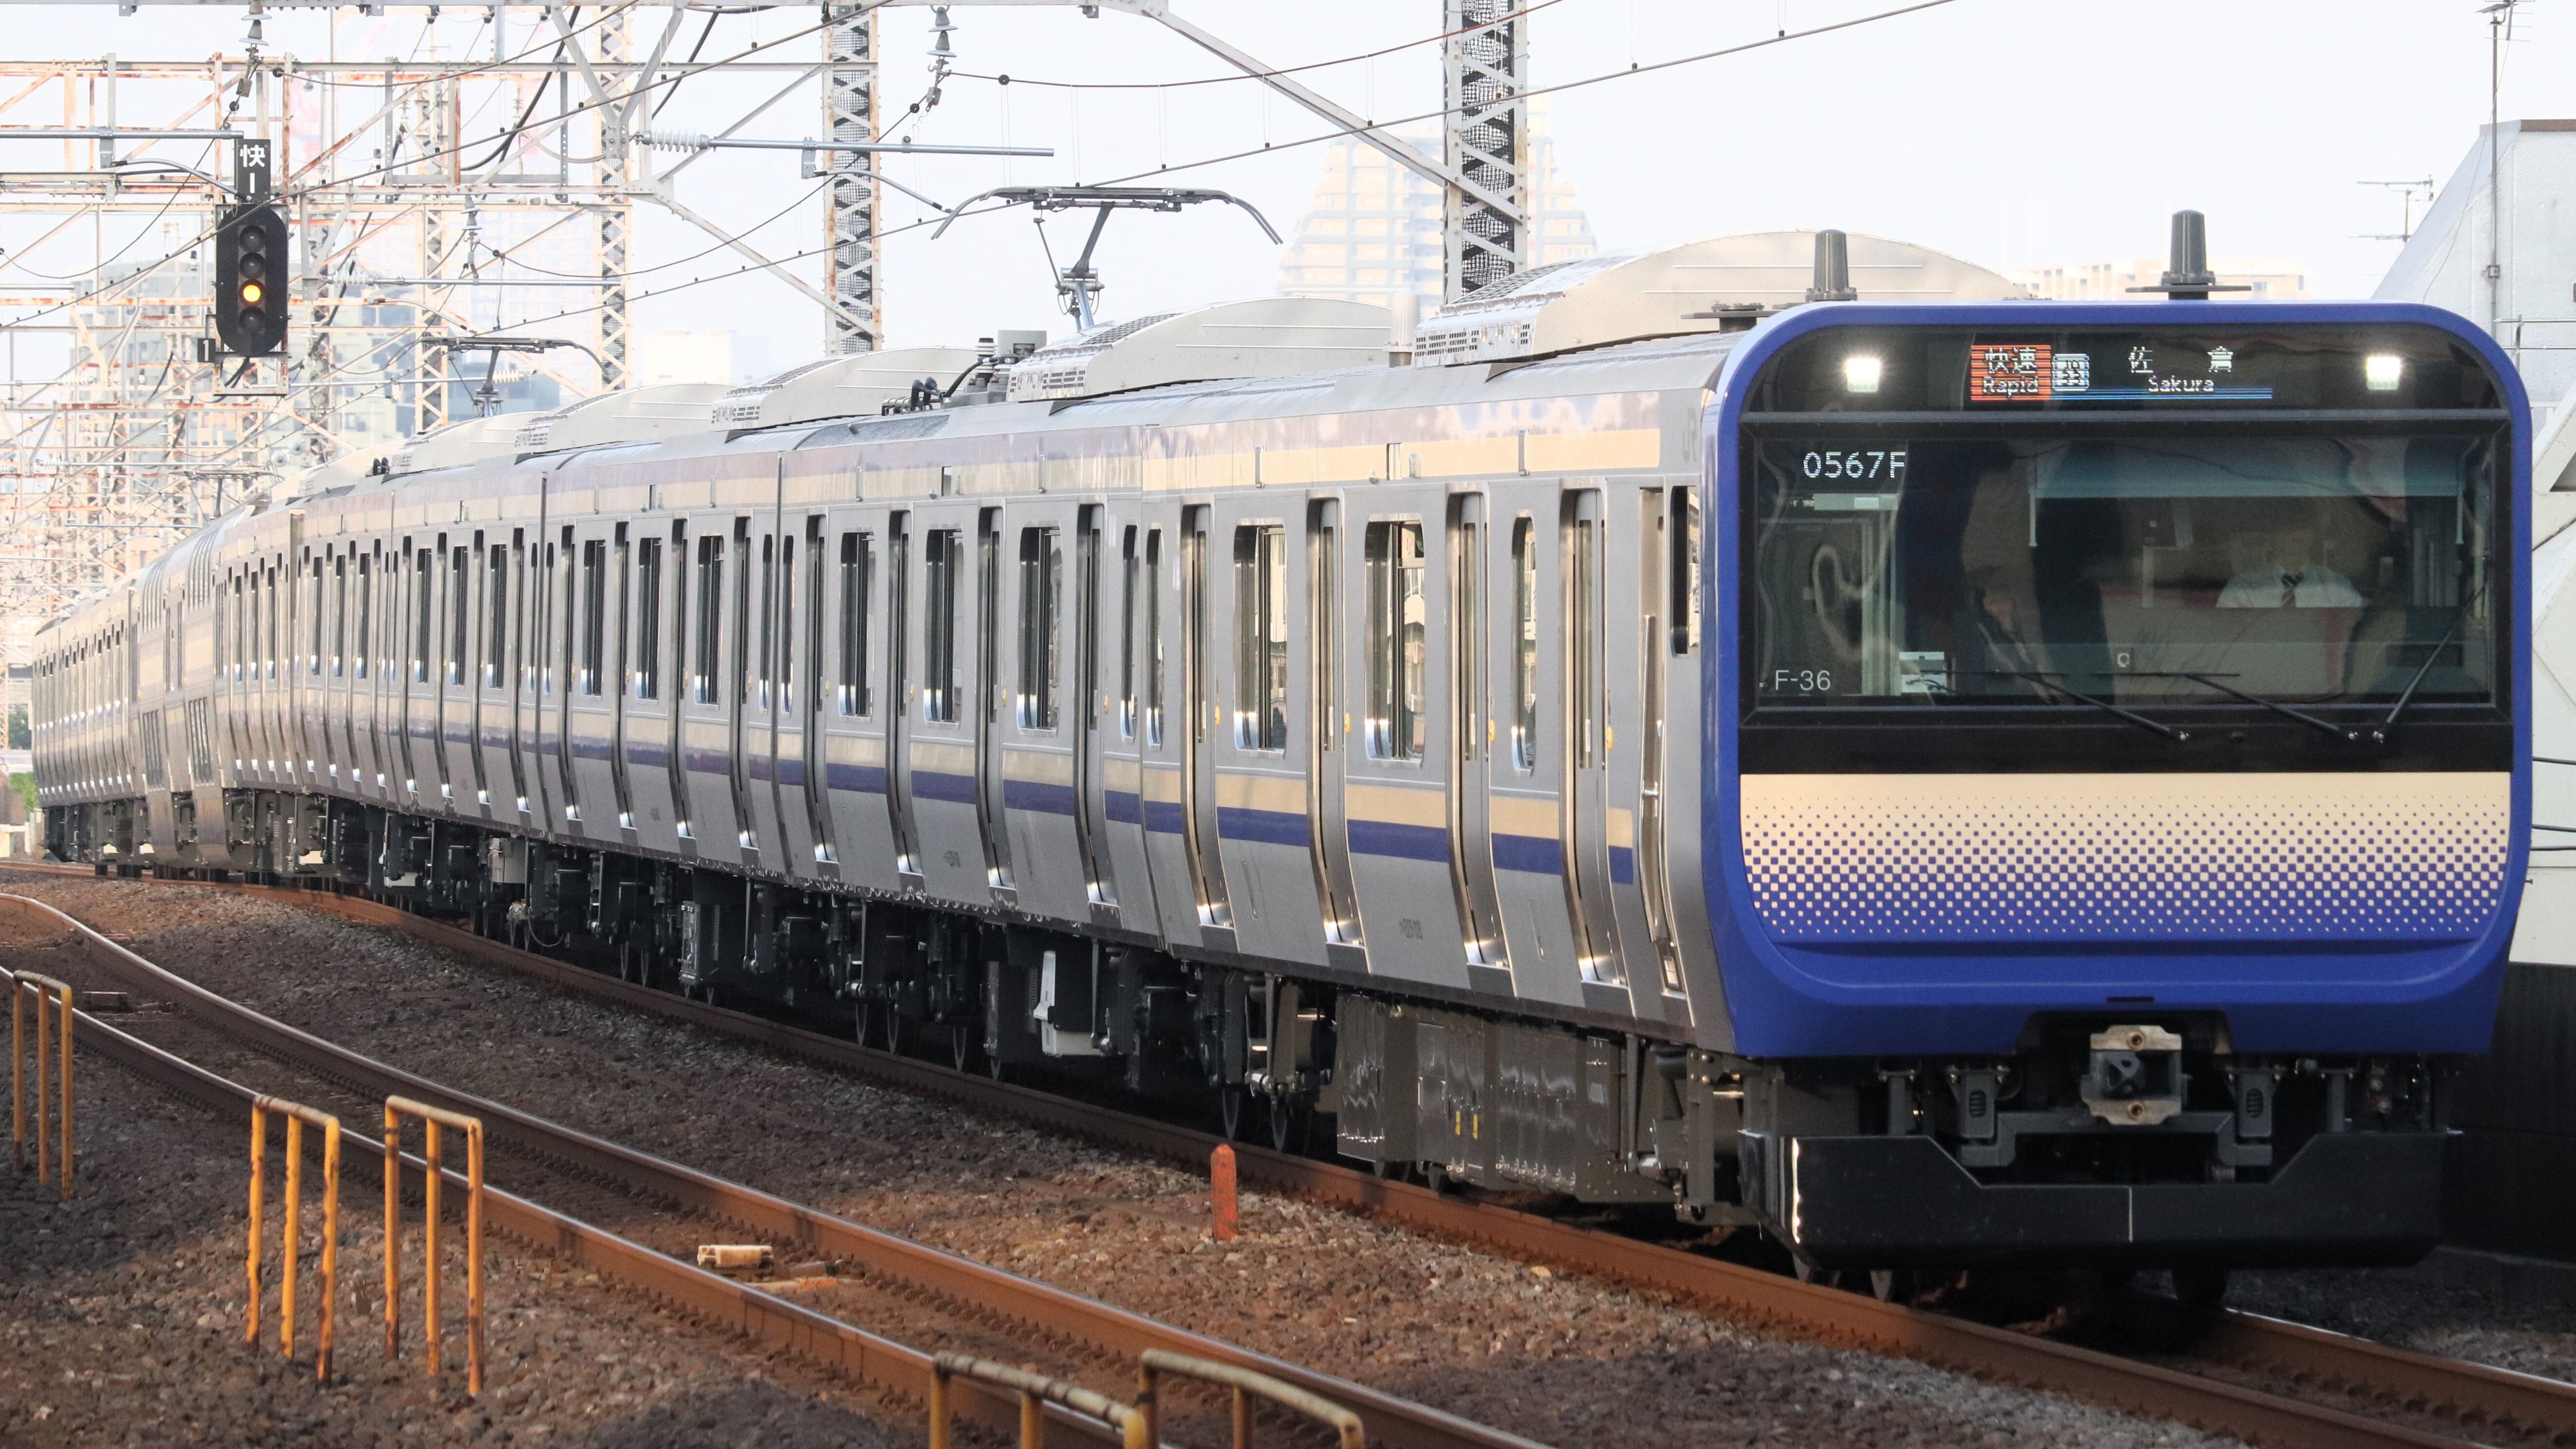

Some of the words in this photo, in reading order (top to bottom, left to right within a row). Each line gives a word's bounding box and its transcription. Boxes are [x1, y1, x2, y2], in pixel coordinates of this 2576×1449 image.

[203, 340, 209, 362] 1
[1984, 347, 2037, 374] 快速
[1982, 376, 2038, 397] Rapid
[2149, 375, 2214, 392] Sakura
[1803, 451, 1906, 478] 0567F
[1775, 670, 1831, 691] F-36
